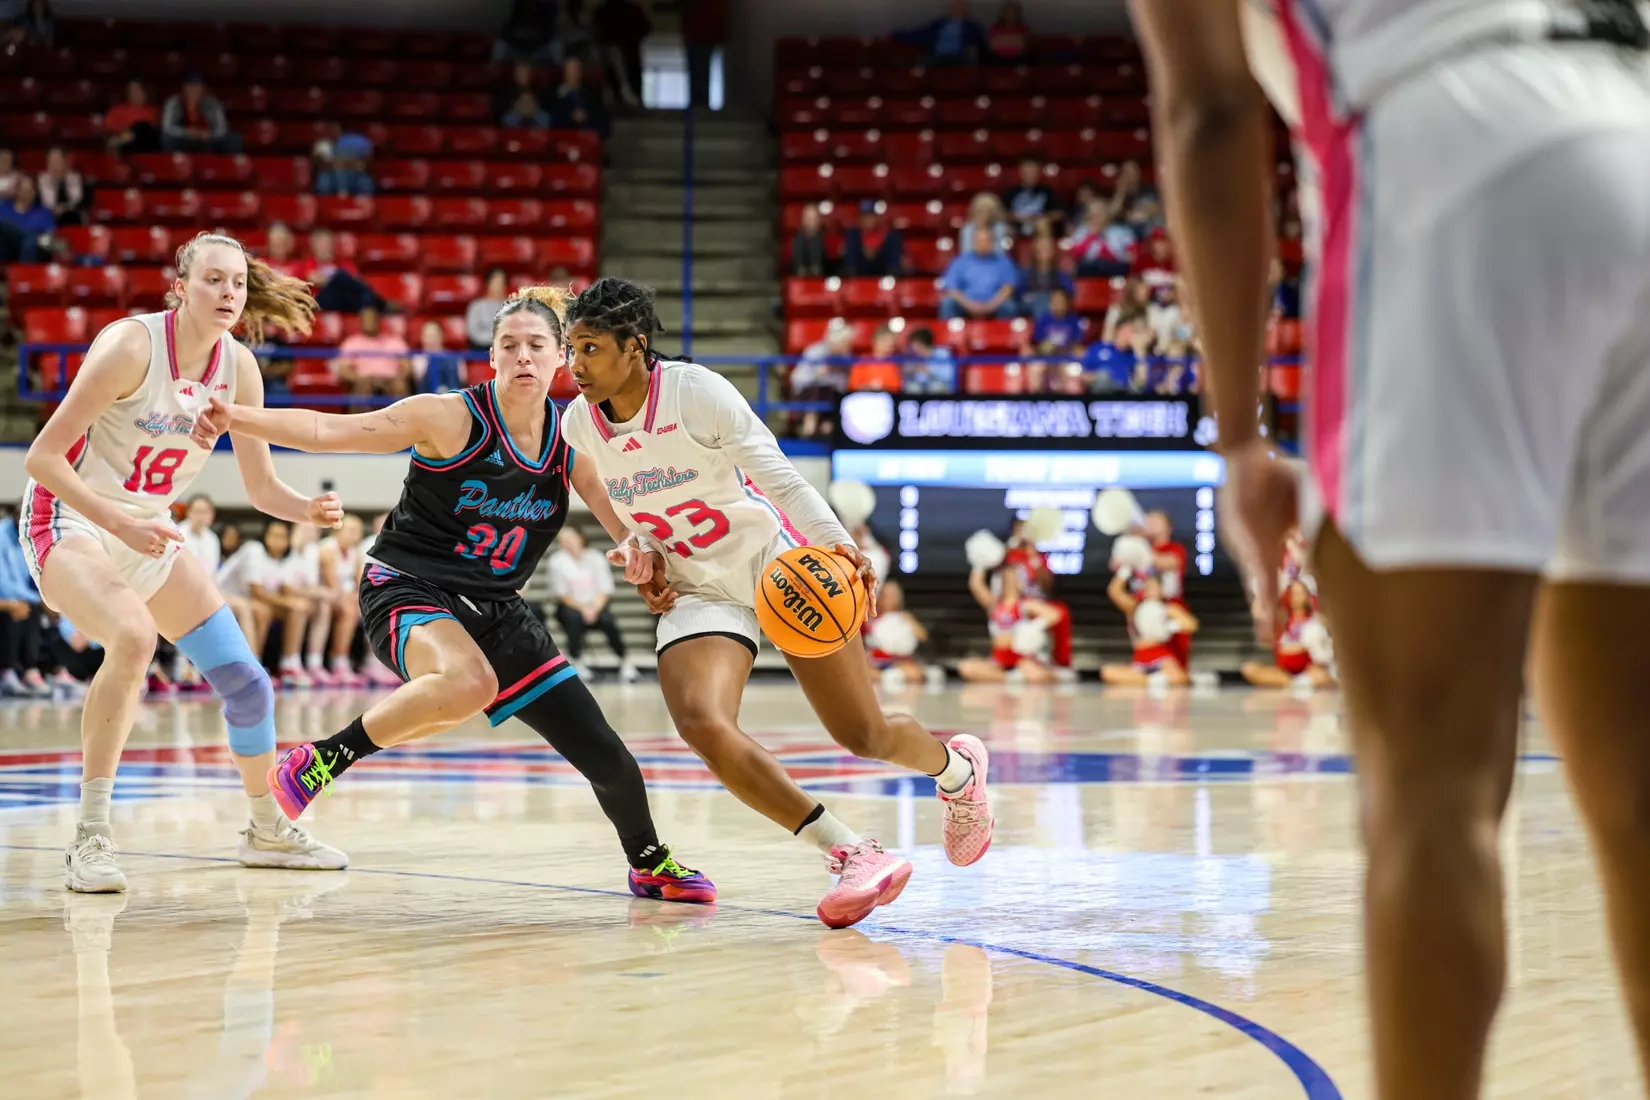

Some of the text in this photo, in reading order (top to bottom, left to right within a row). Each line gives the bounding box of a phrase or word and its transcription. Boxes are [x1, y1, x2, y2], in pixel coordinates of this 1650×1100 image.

[134, 411, 169, 439] Lady
[123, 445, 188, 495] 18
[606, 466, 698, 507] Lady Techsters
[454, 523, 528, 576] 30
[630, 499, 730, 559] 23
[769, 567, 824, 633] Wilson
[798, 554, 844, 599] NCAA
